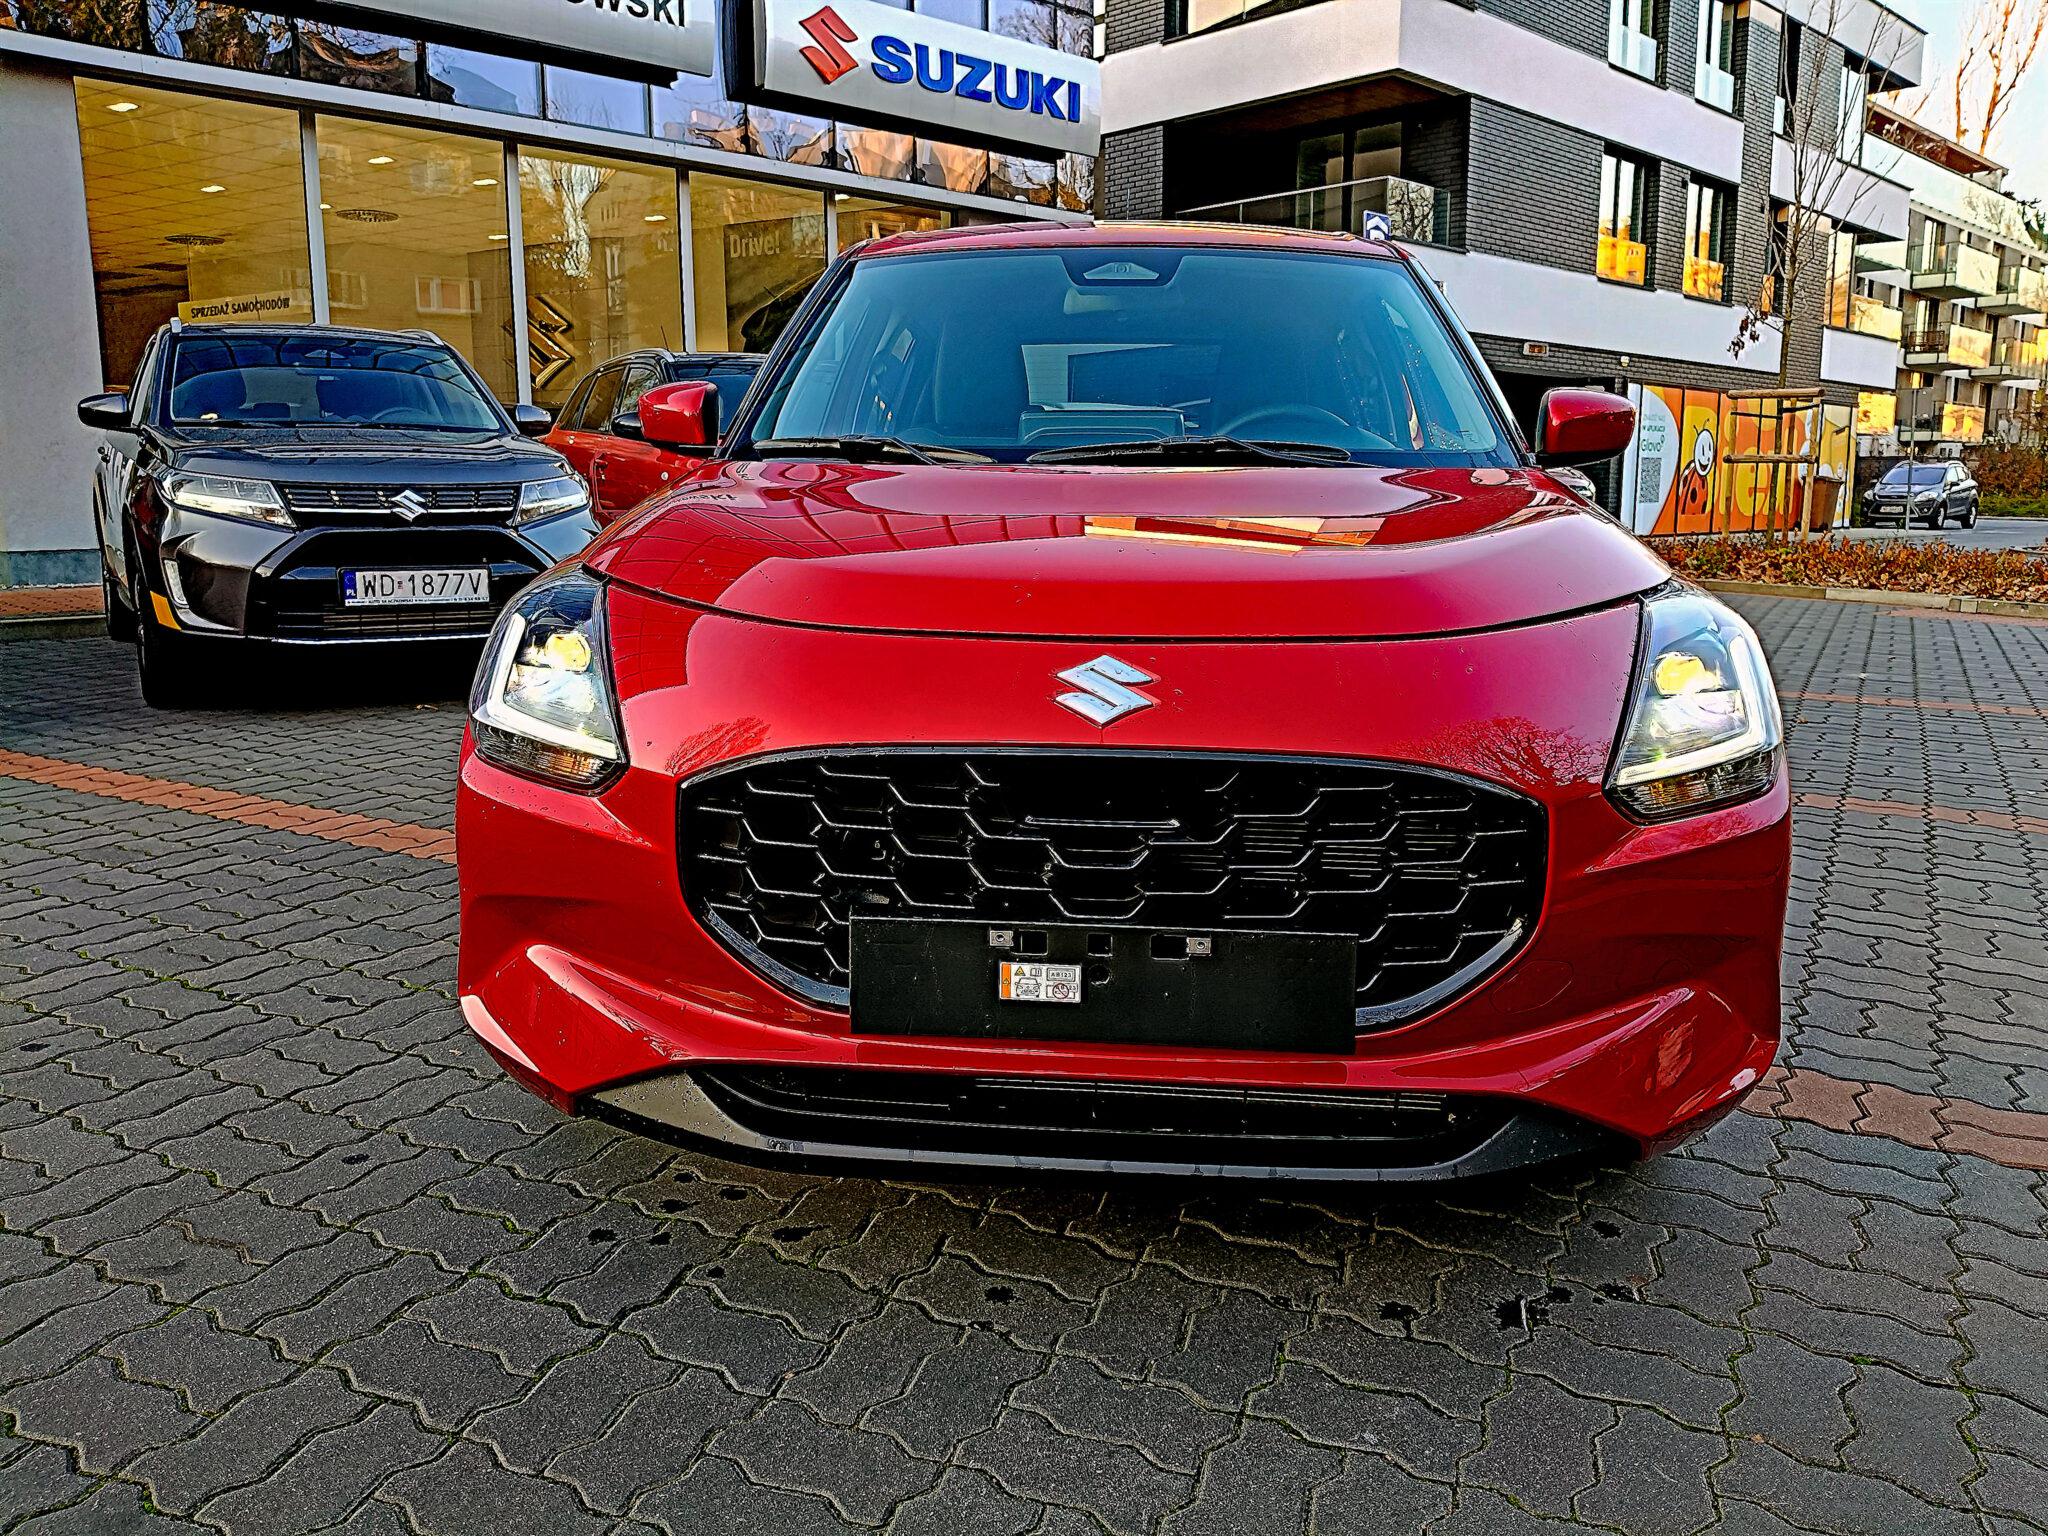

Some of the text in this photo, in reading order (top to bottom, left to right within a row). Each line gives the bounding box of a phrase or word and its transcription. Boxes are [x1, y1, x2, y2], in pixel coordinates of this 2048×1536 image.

[871, 35, 1080, 123] SUZUKI
[729, 230, 780, 258] Drive!
[231, 296, 291, 314] SAMOCHODÓW
[346, 588, 357, 597] PL
[362, 572, 482, 598] WD 1877V
